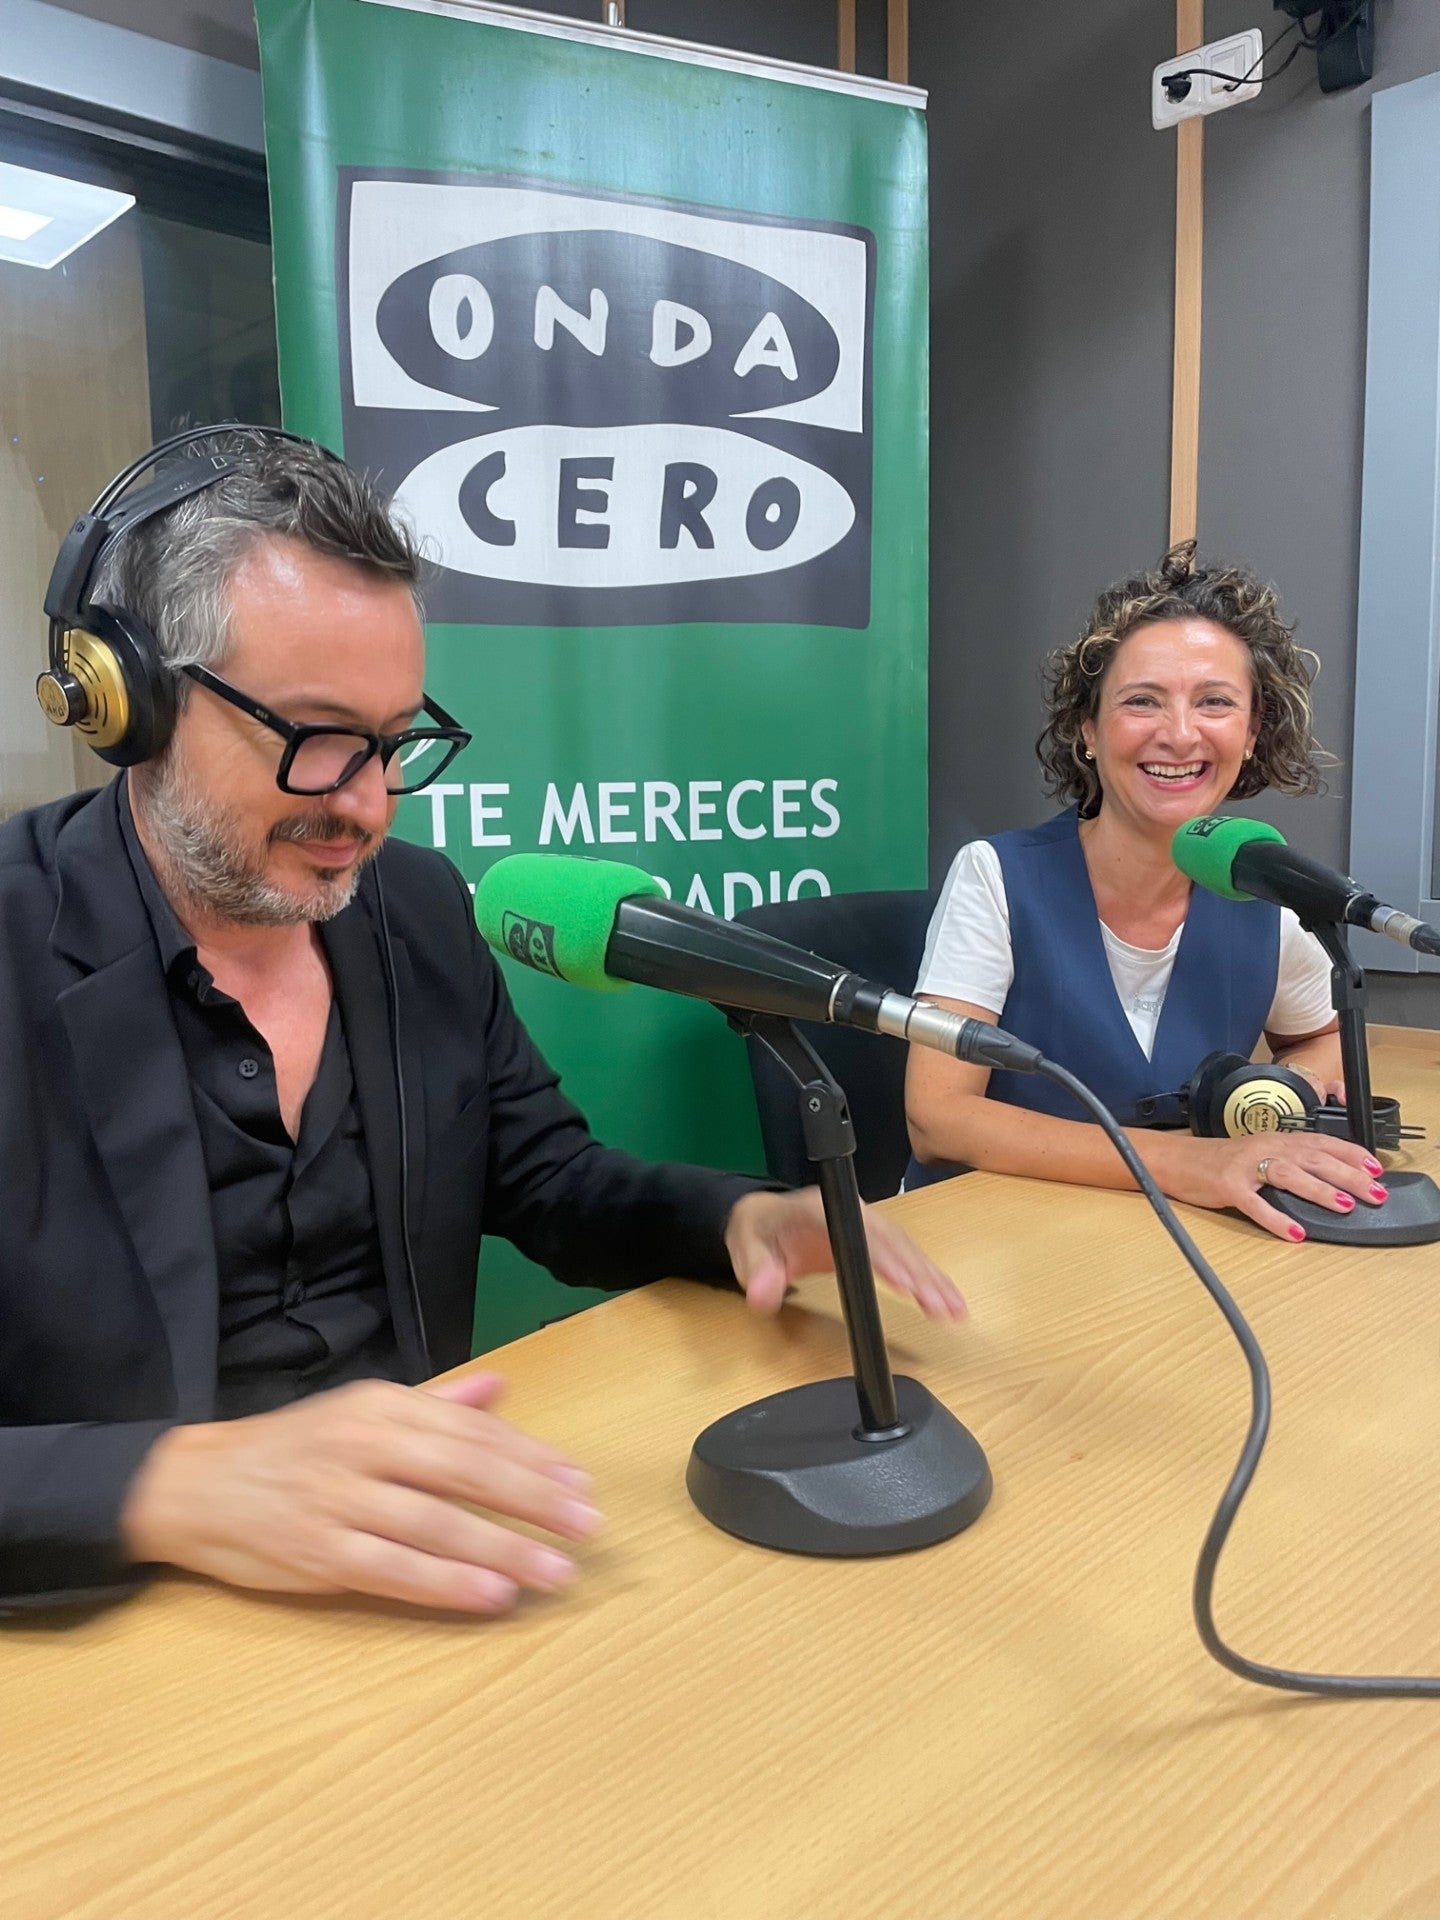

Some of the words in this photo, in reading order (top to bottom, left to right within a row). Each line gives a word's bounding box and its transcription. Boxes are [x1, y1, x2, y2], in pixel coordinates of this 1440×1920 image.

[428, 273, 799, 381] ONDA
[458, 450, 801, 552] CERO
[411, 783, 512, 848] TE
[538, 778, 841, 845] MERECES
[652, 868, 832, 921] ADIO
